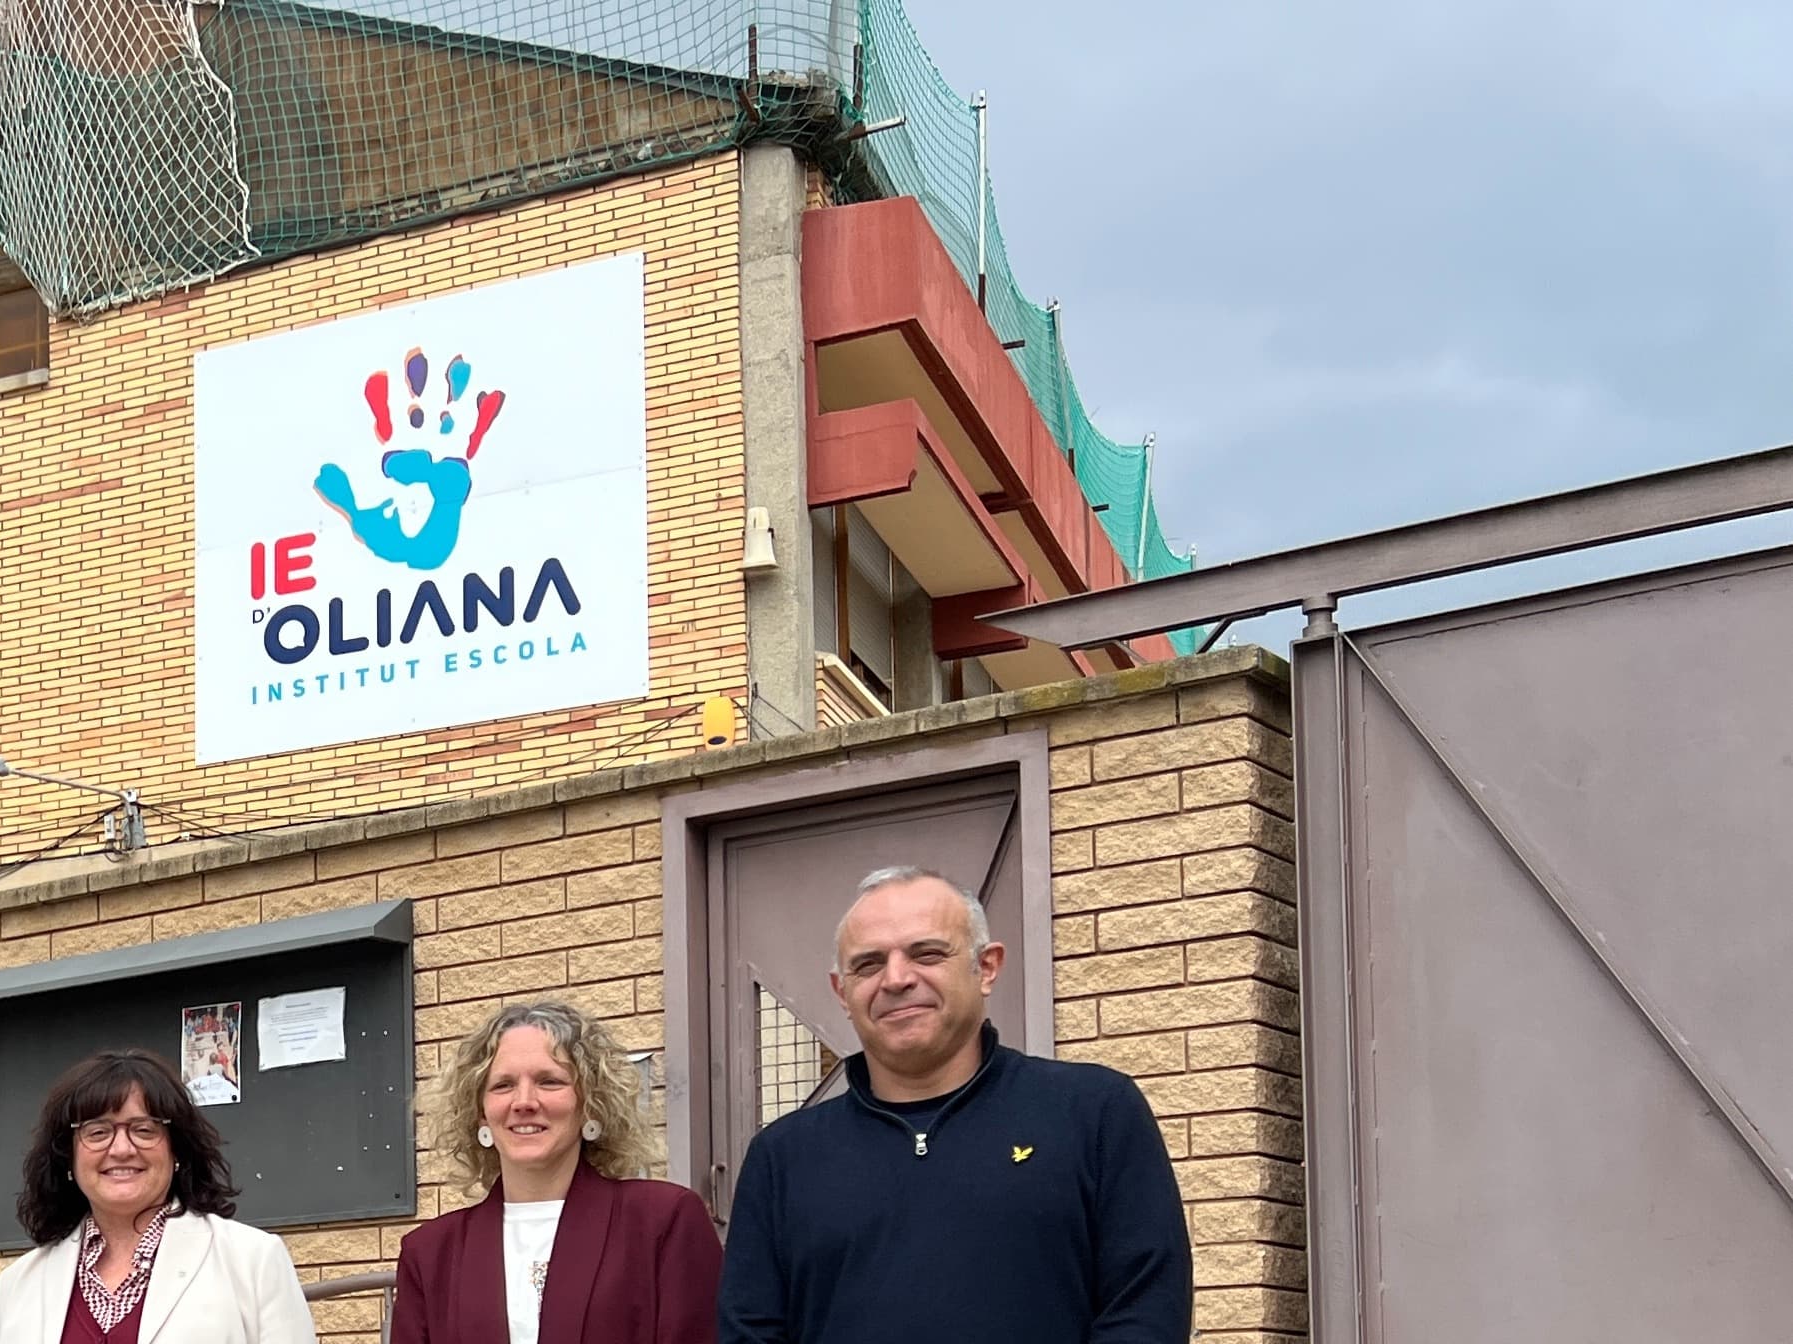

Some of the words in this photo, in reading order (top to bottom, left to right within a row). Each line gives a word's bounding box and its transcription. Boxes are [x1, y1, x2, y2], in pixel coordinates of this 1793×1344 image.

[250, 532, 317, 601] IE
[251, 658, 421, 705] INSTITUT
[444, 631, 588, 673] ESCOLA
